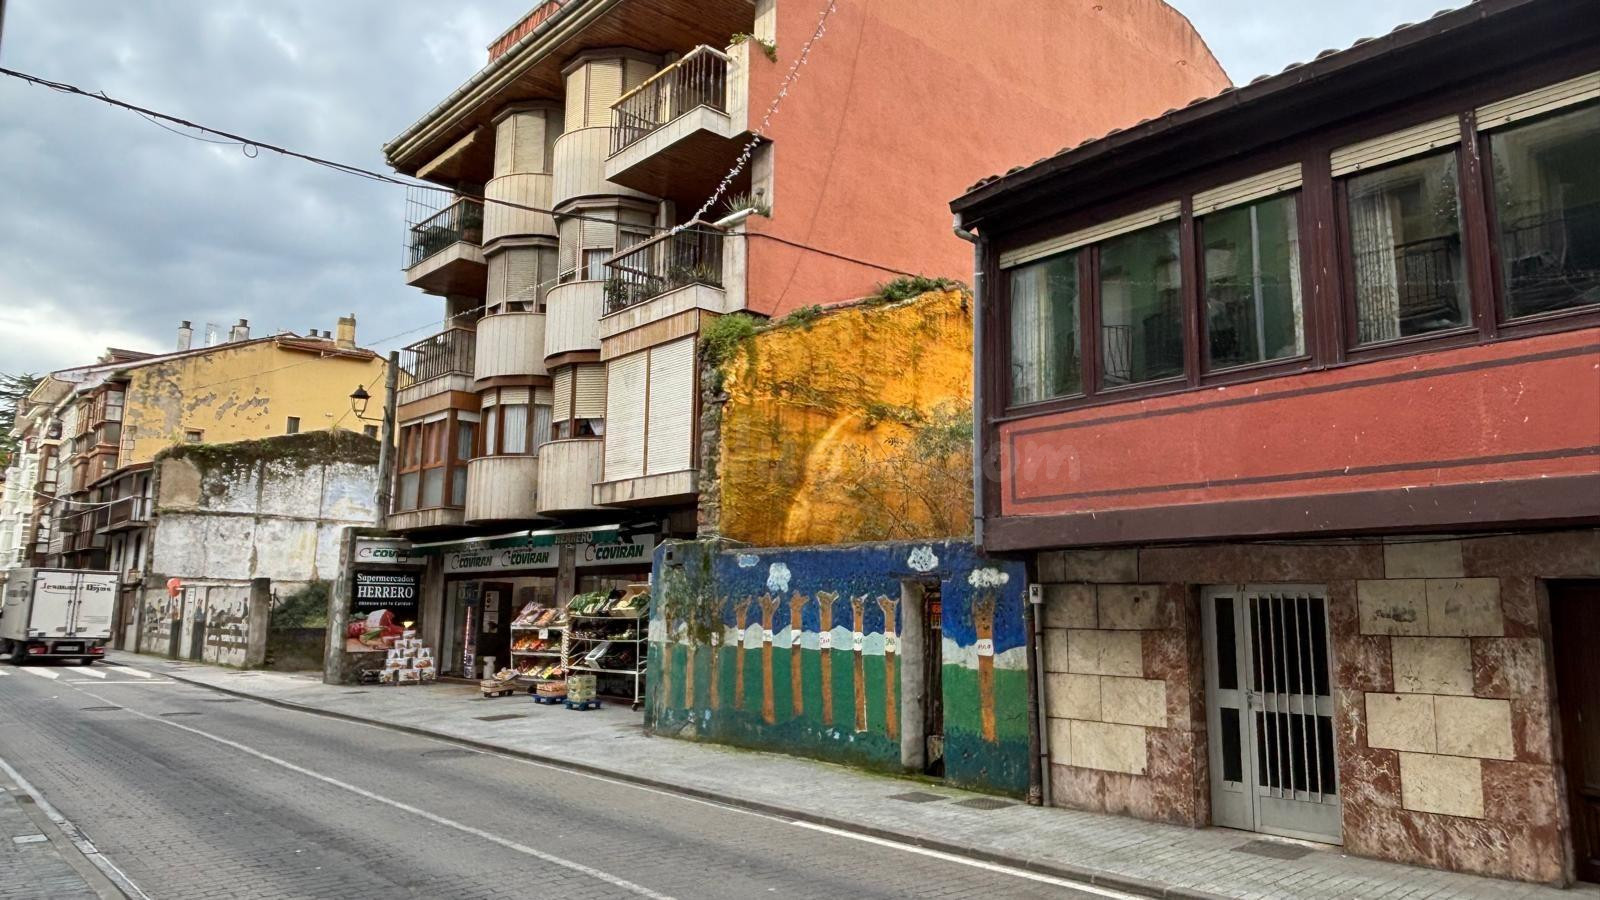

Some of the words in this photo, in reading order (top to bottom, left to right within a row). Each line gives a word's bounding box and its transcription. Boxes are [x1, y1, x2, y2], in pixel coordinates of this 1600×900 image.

[595, 544, 645, 560] COVIRAN
[458, 555, 493, 568] COVIRAN
[510, 551, 549, 565] COVIRAN
[357, 573, 414, 583] Supermercados
[357, 585, 414, 598] HERRERO
